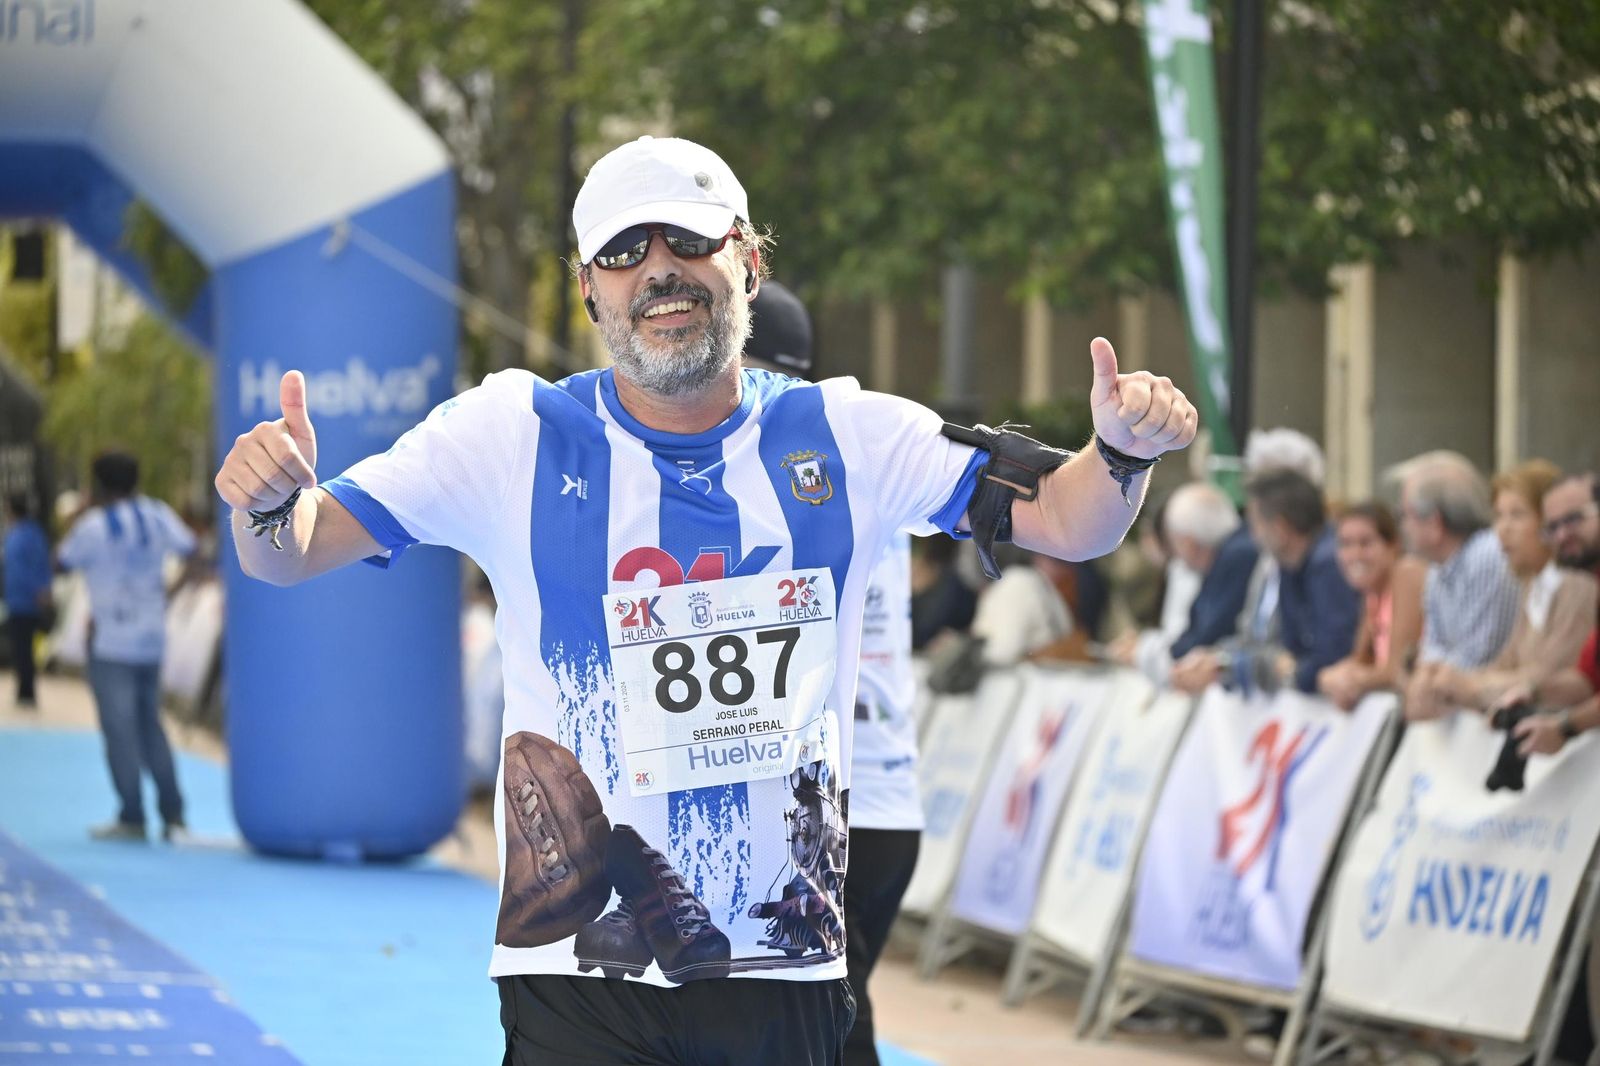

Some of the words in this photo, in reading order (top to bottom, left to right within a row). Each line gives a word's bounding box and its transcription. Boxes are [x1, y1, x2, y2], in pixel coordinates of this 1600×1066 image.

[239, 356, 428, 418] Helva
[716, 609, 755, 621] HUELVA
[779, 607, 822, 621] HUELVA
[621, 626, 668, 642] HUELVA
[652, 626, 801, 713] 887
[715, 709, 738, 721] JOSE
[740, 707, 758, 718] LUIS
[693, 723, 746, 741] SERRANO
[749, 719, 784, 733] PERAL
[688, 739, 782, 770] Huelva
